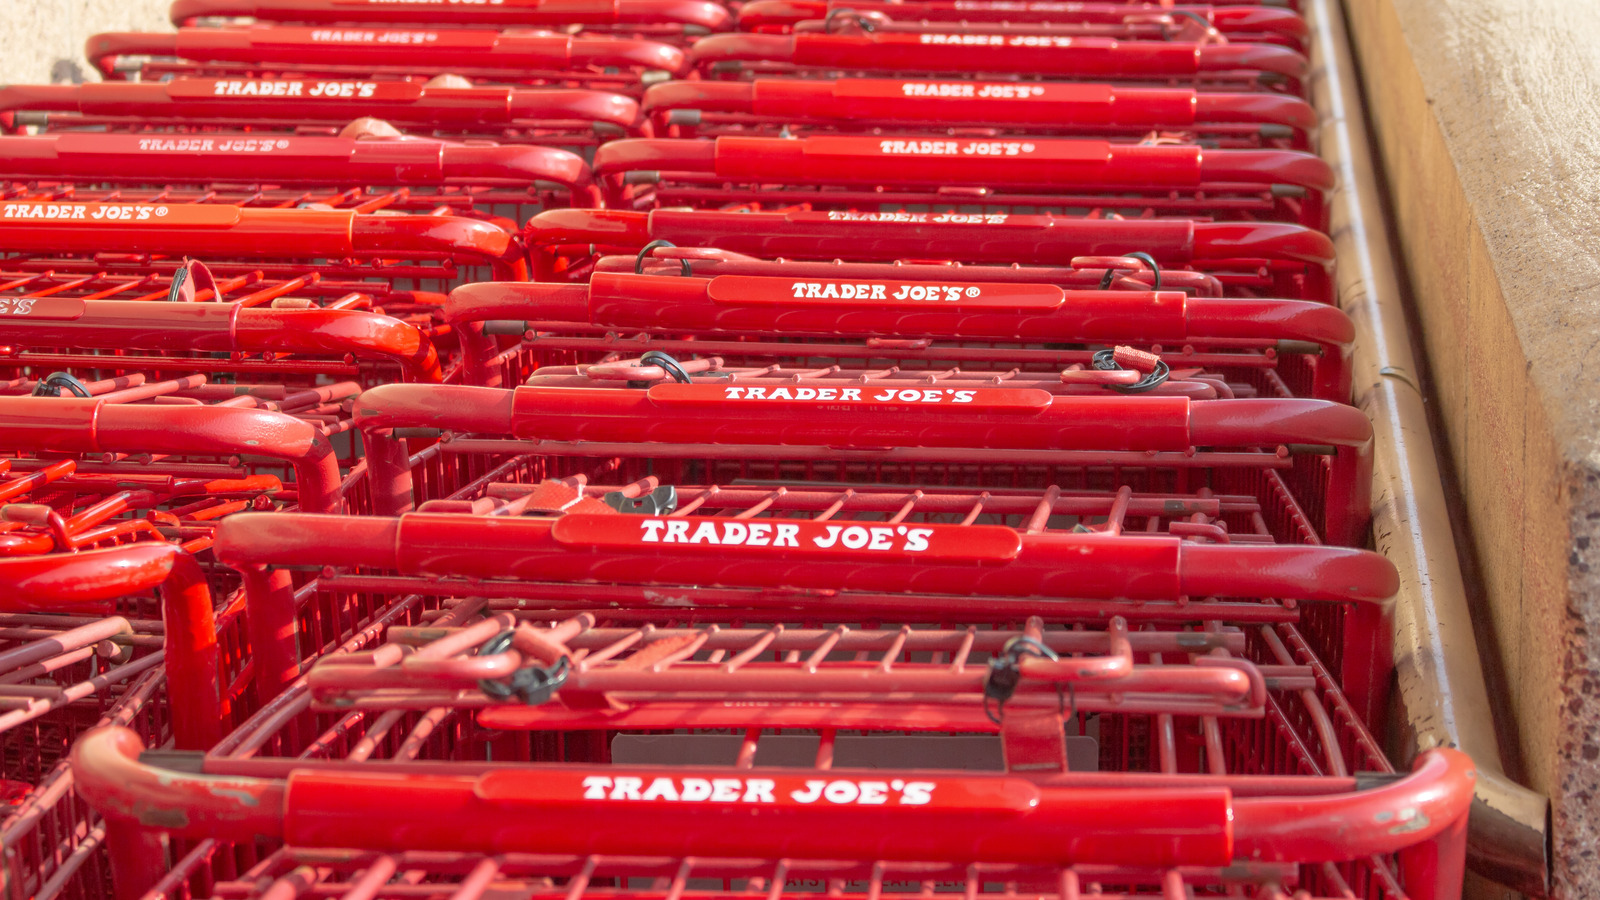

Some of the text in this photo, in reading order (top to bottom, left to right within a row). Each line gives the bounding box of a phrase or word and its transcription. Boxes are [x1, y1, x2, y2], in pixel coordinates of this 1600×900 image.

[214, 81, 377, 98] TRADER JOE'S
[902, 83, 975, 97] TRADER
[139, 138, 214, 151] TRADER
[879, 140, 958, 155] TRADER
[3, 204, 87, 219] TRADER
[828, 211, 927, 223] TRADER
[791, 282, 887, 300] TRADER
[724, 386, 977, 403] TRADER JOE'S
[640, 519, 934, 551] TRADER JOE'S
[583, 775, 935, 805] TRADER JOE'S
